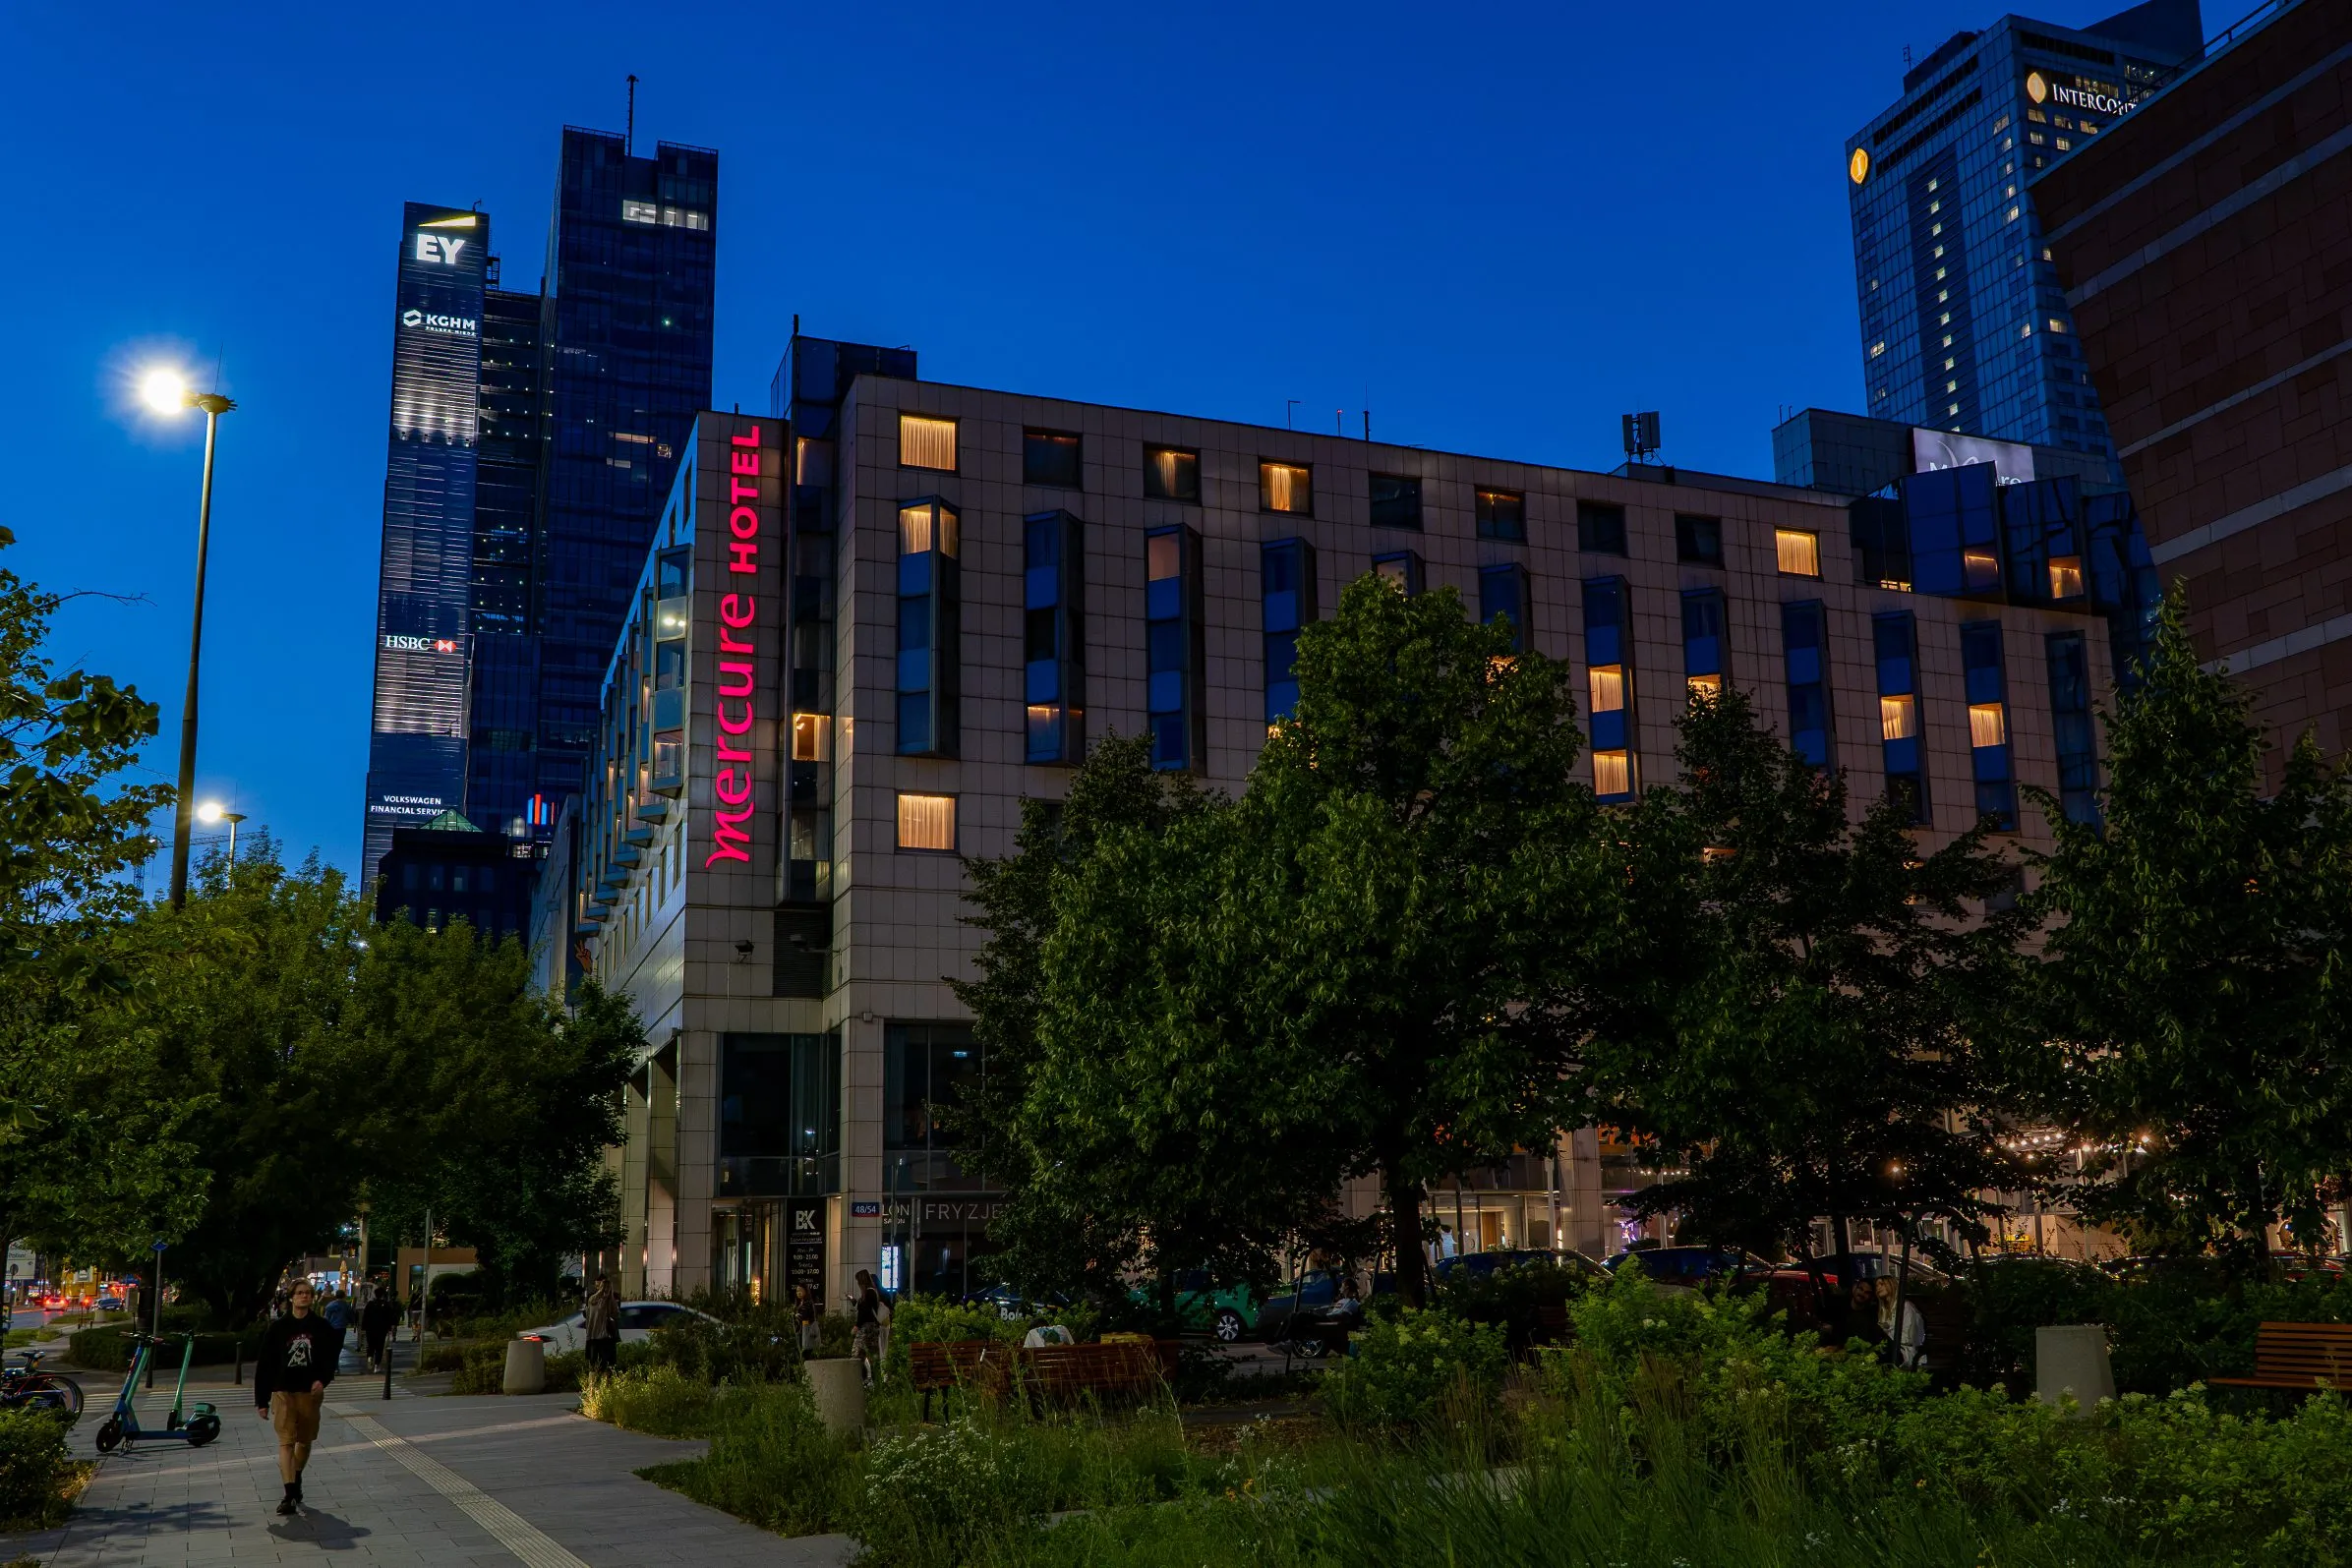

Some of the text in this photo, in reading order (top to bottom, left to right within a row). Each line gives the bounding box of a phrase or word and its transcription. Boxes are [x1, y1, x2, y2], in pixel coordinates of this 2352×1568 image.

[417, 233, 465, 263] EY
[426, 314, 476, 330] KGHM
[730, 425, 760, 574] HOTEL
[384, 635, 431, 651] HSBC
[383, 794, 441, 806] VOLKSWAGEN
[371, 805, 414, 815] FINANCIAL
[855, 1205, 876, 1214] 48/54
